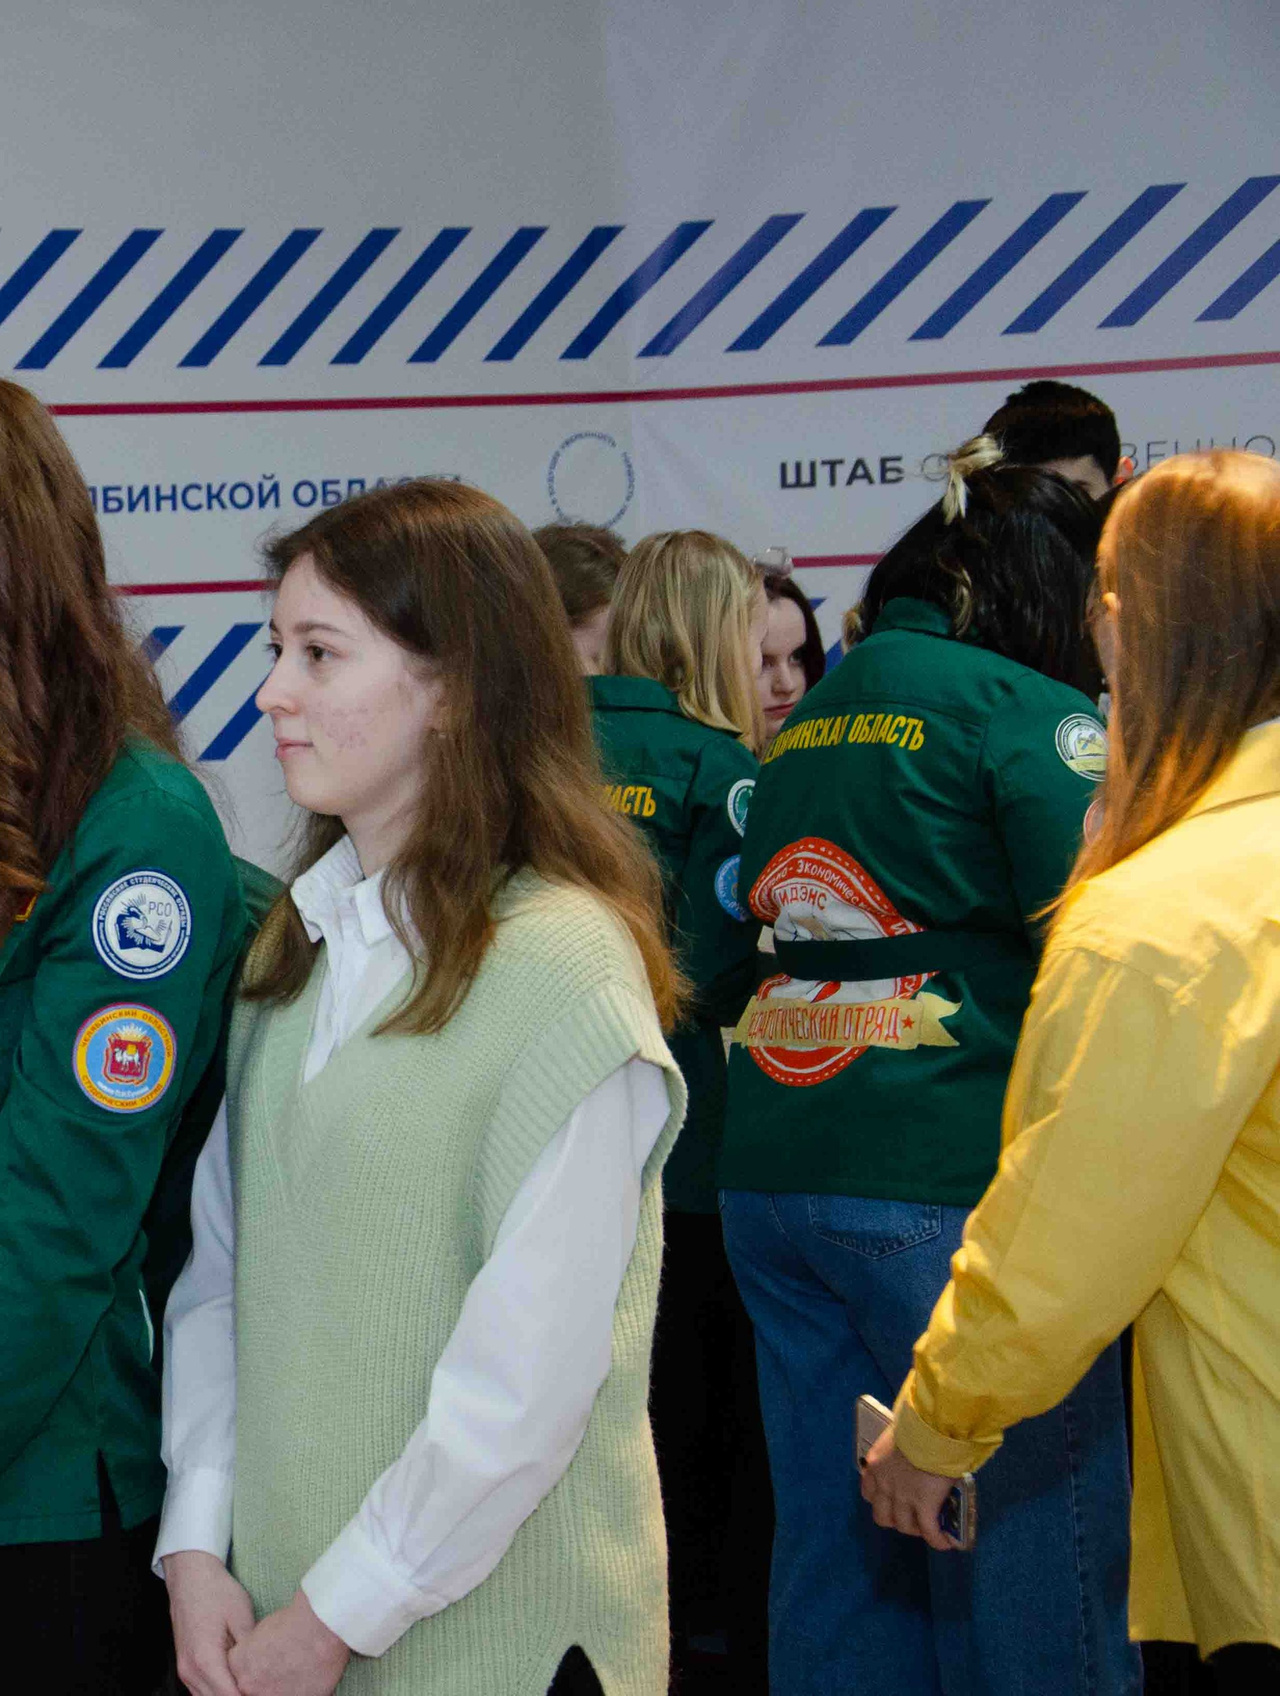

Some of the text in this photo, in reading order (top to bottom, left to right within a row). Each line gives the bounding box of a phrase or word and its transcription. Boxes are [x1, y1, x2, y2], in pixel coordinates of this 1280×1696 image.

[780, 455, 905, 490] ШТАБ
[847, 713, 925, 751] ОБЛАСТЬ
[843, 1005, 902, 1043] ОТРЯД
